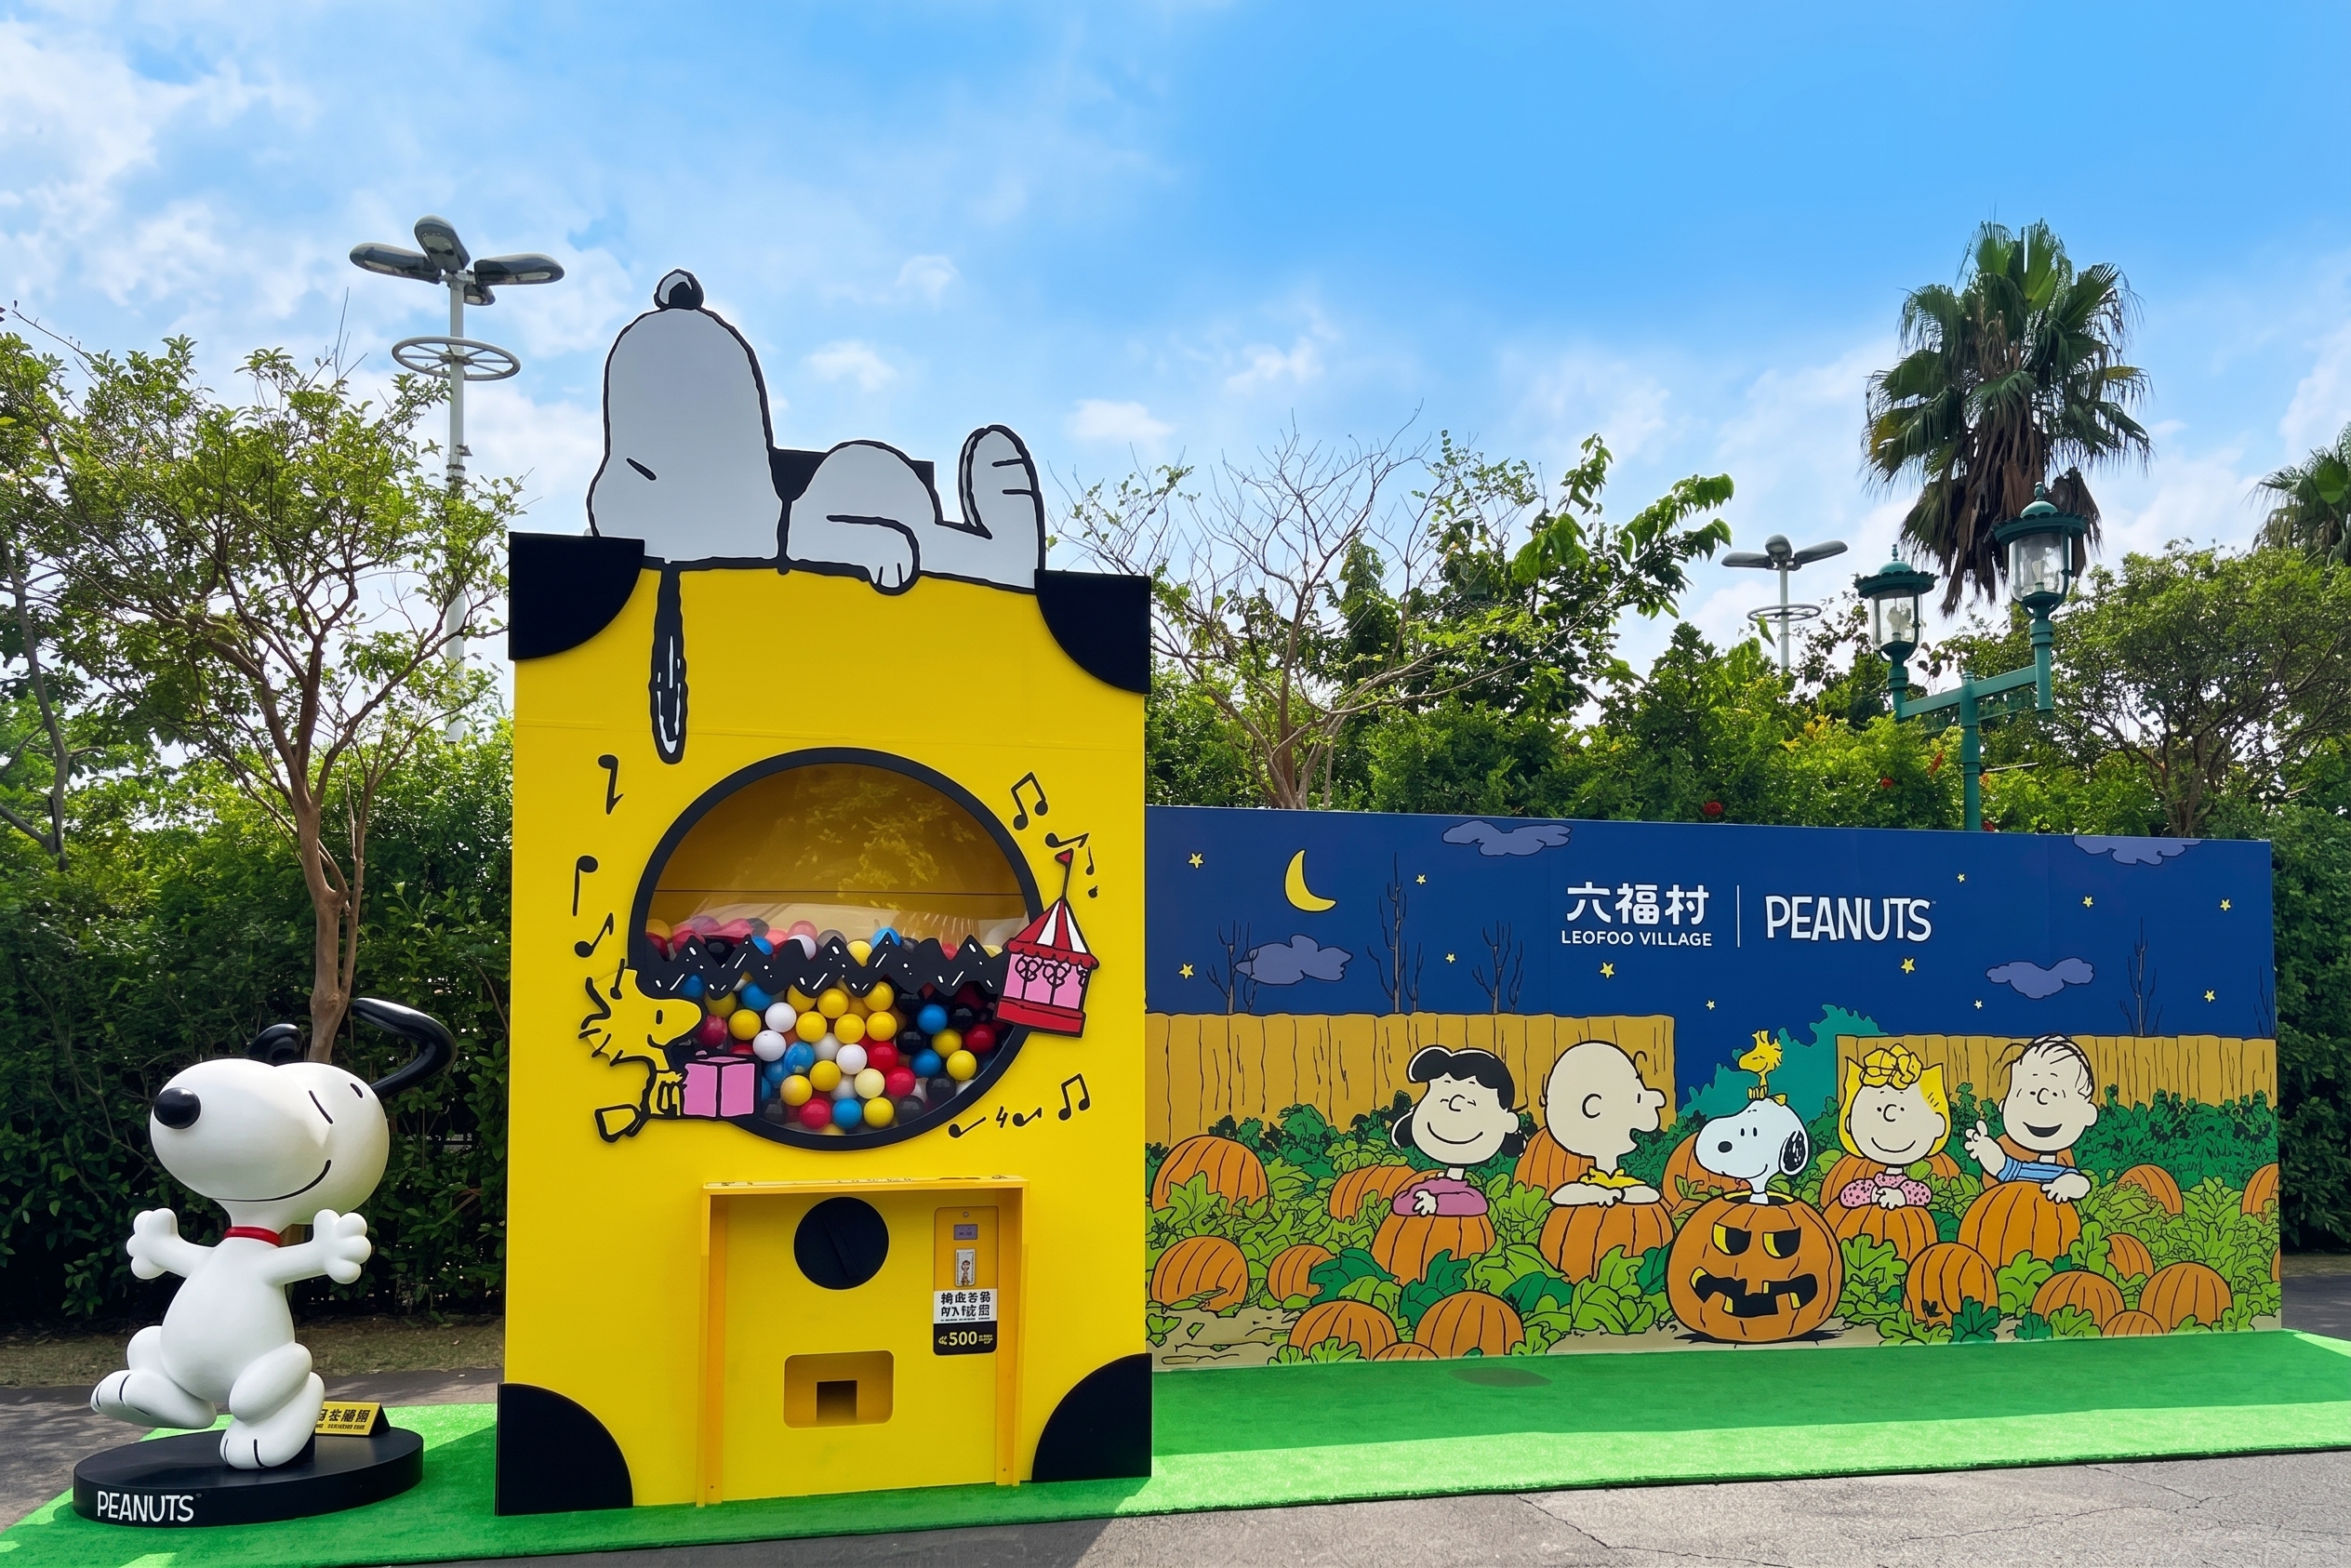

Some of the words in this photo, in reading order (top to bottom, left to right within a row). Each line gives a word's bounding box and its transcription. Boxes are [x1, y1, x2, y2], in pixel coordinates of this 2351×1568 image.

[1566, 881, 1709, 925] 六福村
[1765, 895, 1933, 942] PEANUTS
[1561, 930, 1634, 945] LEOFOO
[1640, 932, 1712, 947] VILLAGE
[949, 1331, 977, 1347] 500
[97, 1490, 194, 1522] PEANUTS
